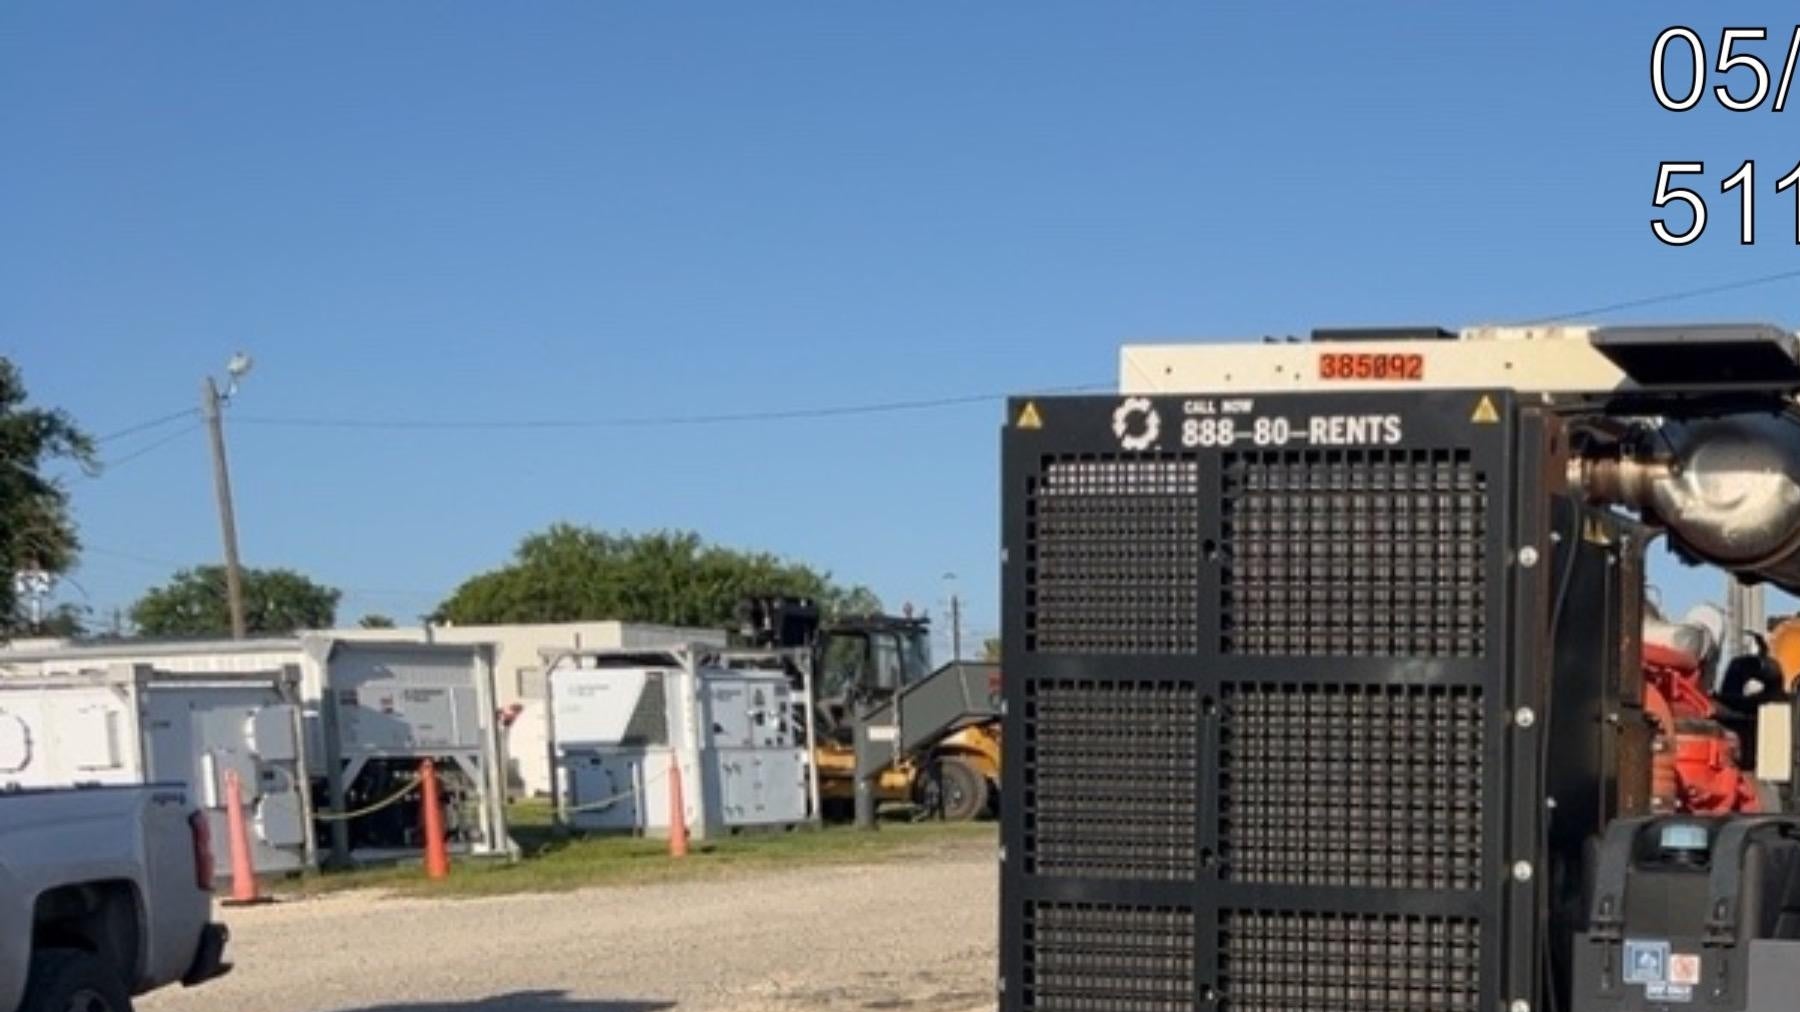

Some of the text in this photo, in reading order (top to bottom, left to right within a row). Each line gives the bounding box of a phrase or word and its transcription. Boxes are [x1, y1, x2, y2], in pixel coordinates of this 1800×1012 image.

[1319, 352, 1424, 380] 385092
[1183, 400, 1216, 415] CALL
[1181, 413, 1402, 446] 888-80-RENTS
